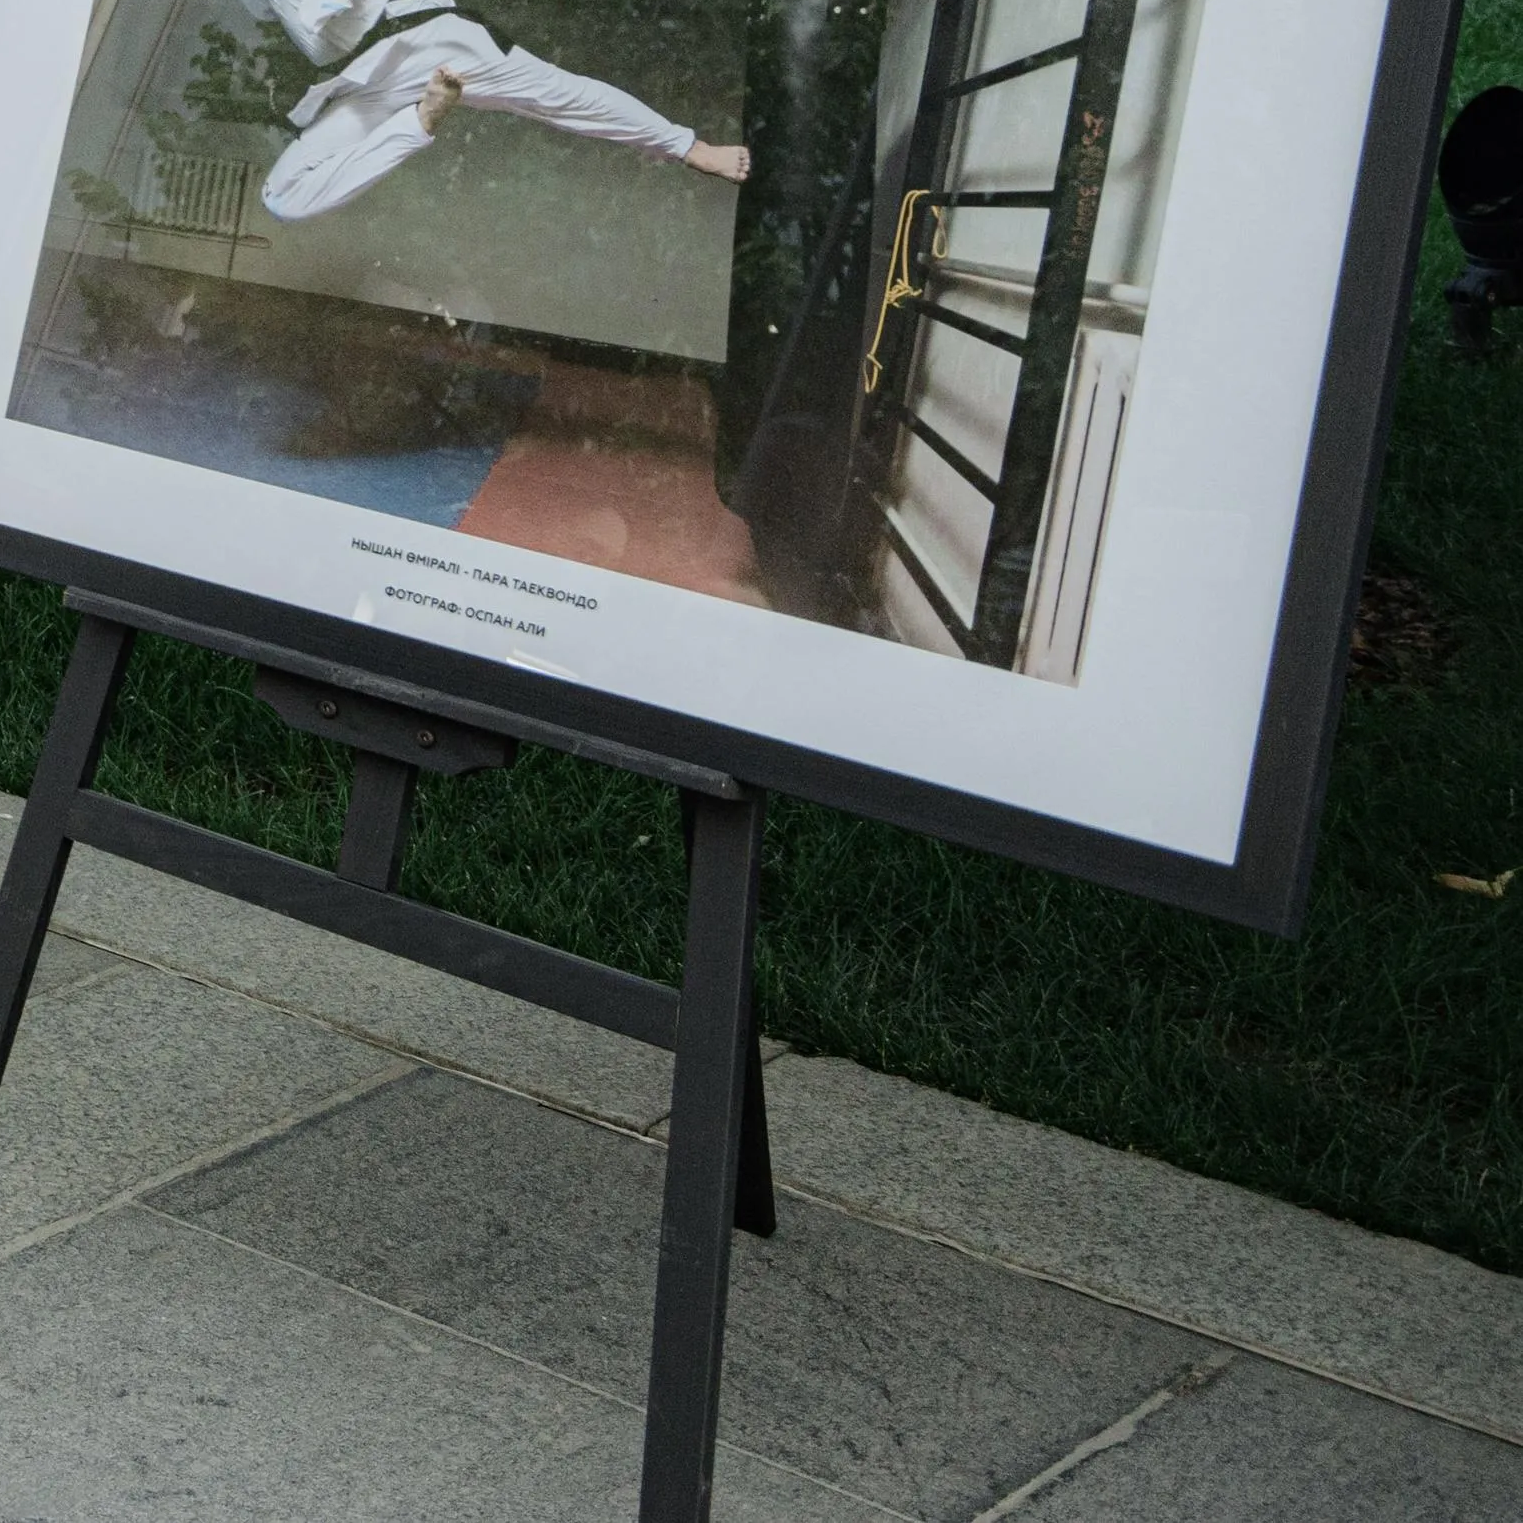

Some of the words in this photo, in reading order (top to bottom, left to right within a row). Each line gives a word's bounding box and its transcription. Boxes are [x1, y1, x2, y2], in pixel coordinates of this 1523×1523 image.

[350, 537, 403, 560] НЫШАН
[406, 550, 460, 575] ӨМІРАЛІ
[473, 568, 509, 589] ПАРА
[512, 577, 598, 612] ТАЕКВОНДО
[384, 585, 462, 616] ФОТОГРАФ:
[465, 606, 513, 630] ОСПАН
[516, 620, 546, 638] АЛИ
